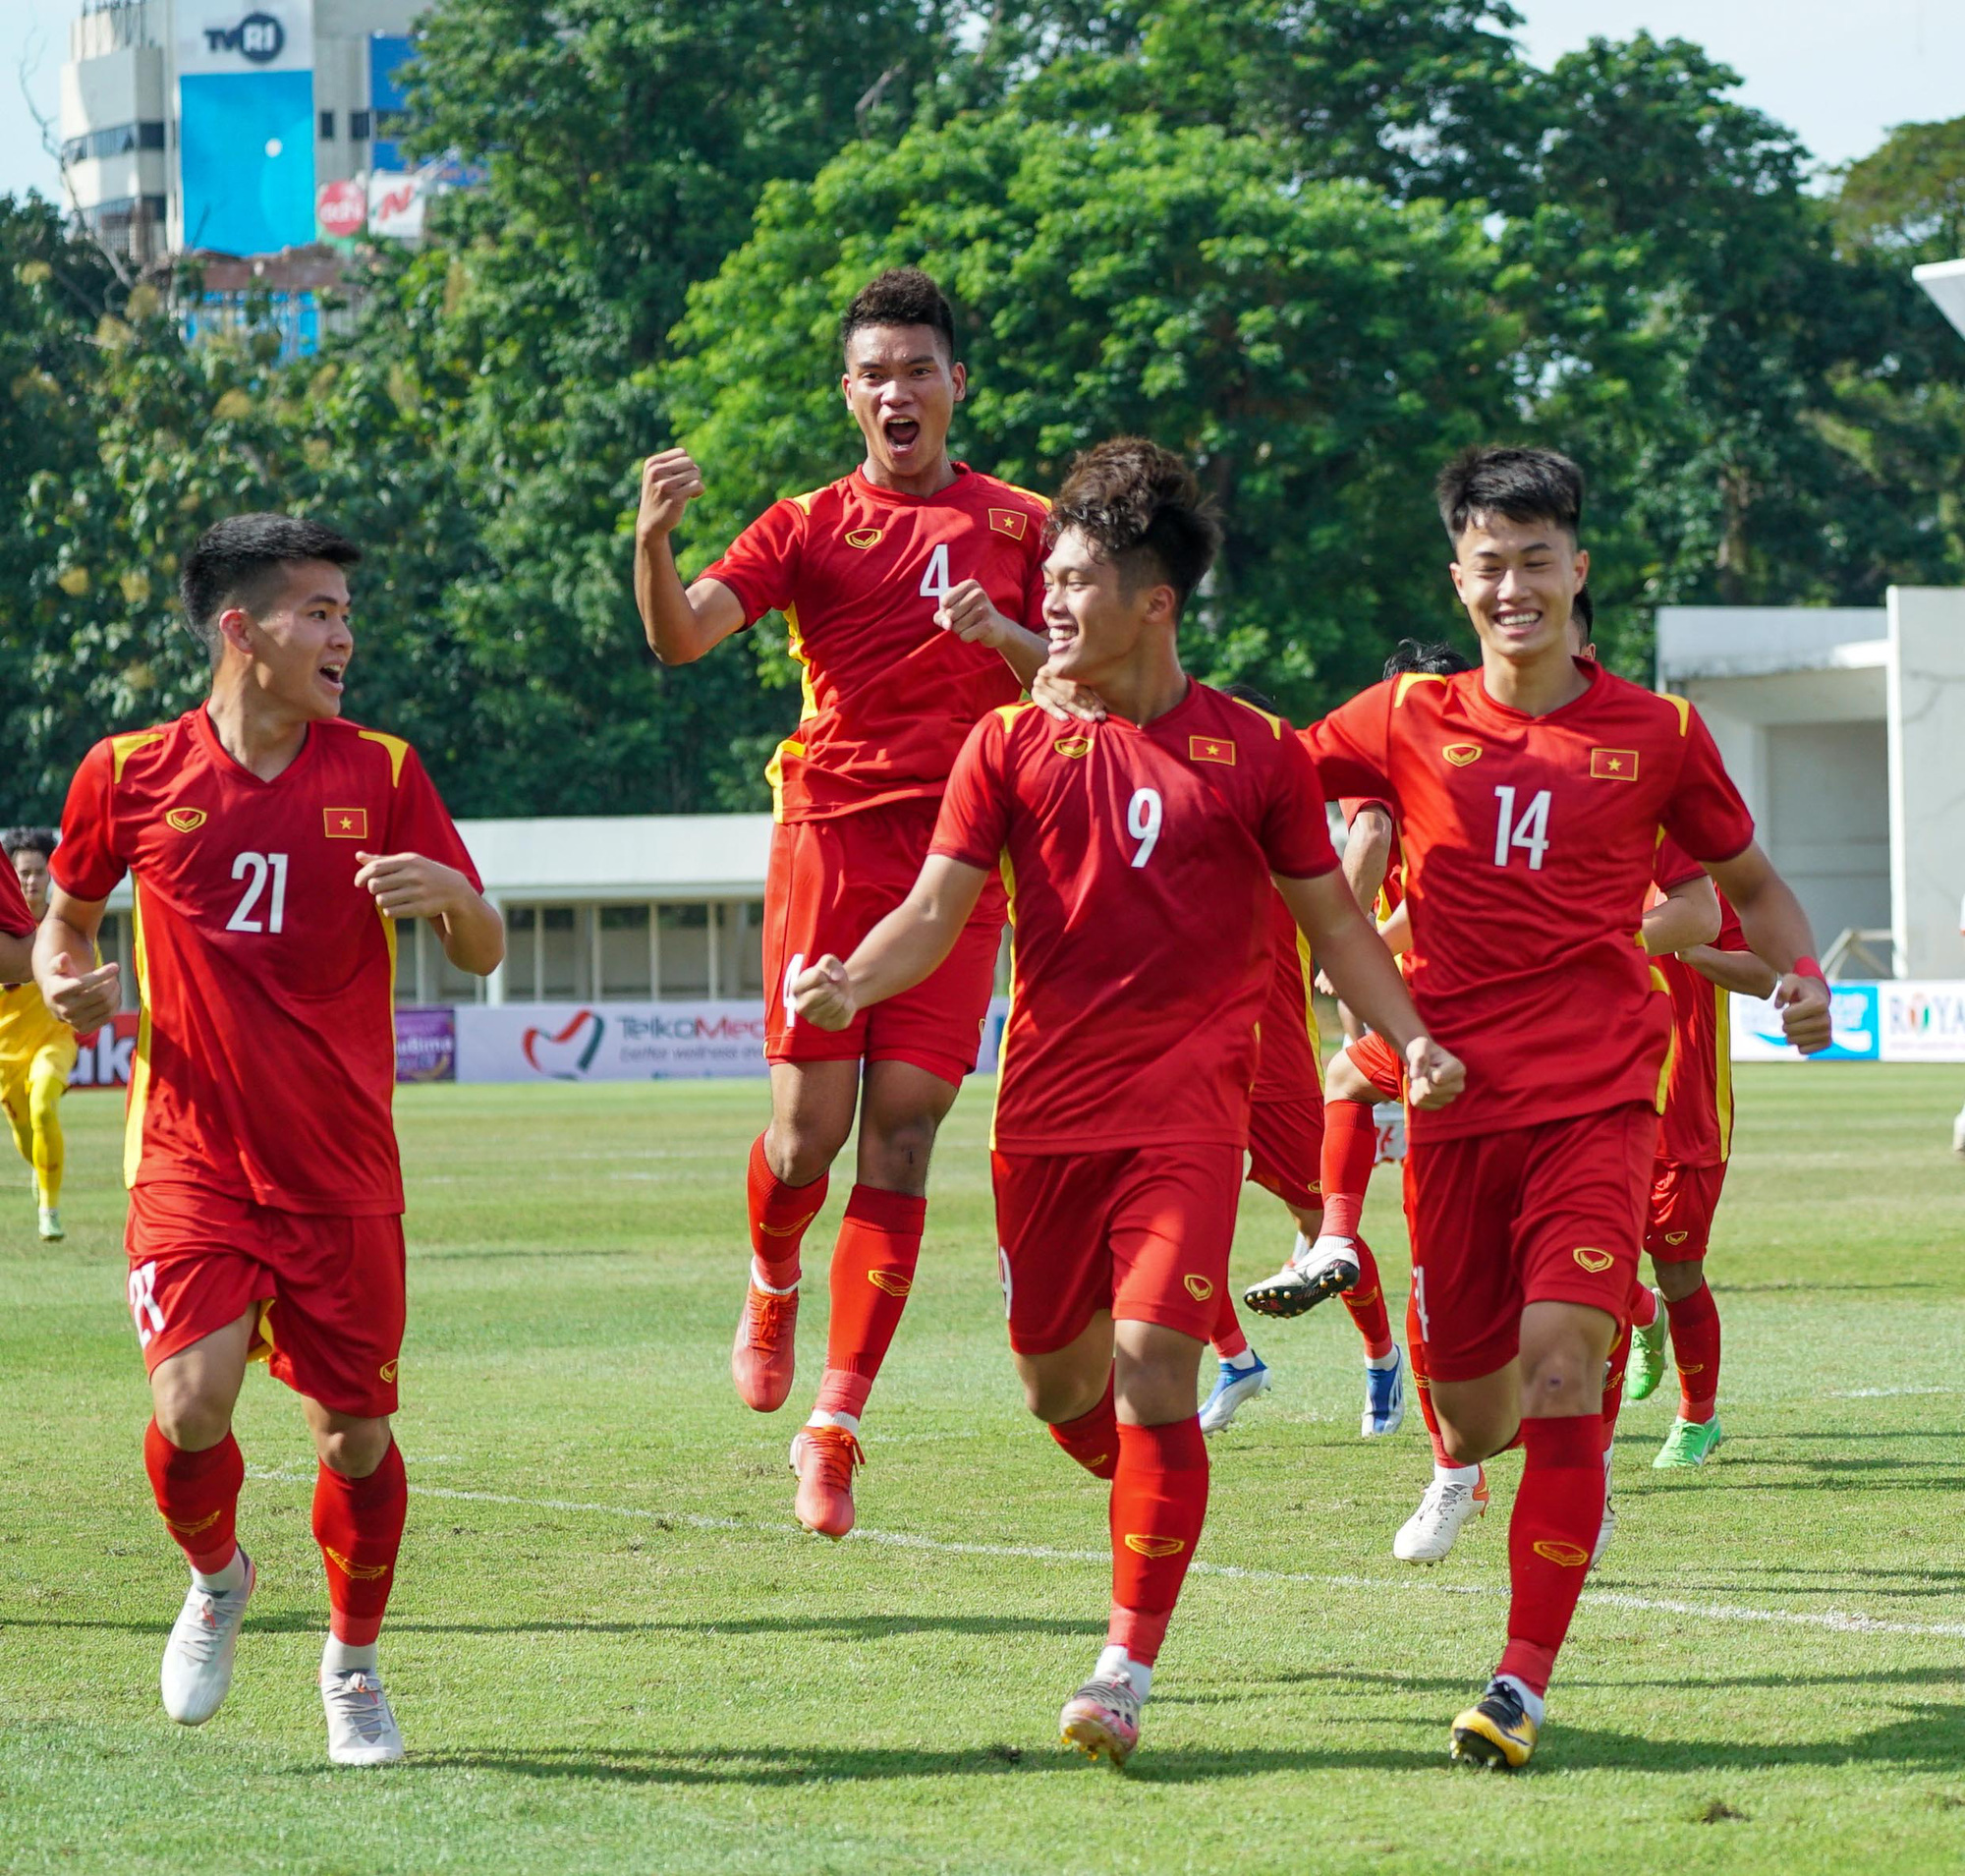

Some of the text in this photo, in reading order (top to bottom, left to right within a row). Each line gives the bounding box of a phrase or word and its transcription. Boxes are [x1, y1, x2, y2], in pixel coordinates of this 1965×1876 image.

[203, 19, 278, 55] TVRI
[920, 543, 953, 611] 4
[1127, 787, 1162, 868] 9
[1494, 785, 1551, 871] 14
[225, 851, 289, 934] 21
[129, 1261, 165, 1349] 21
